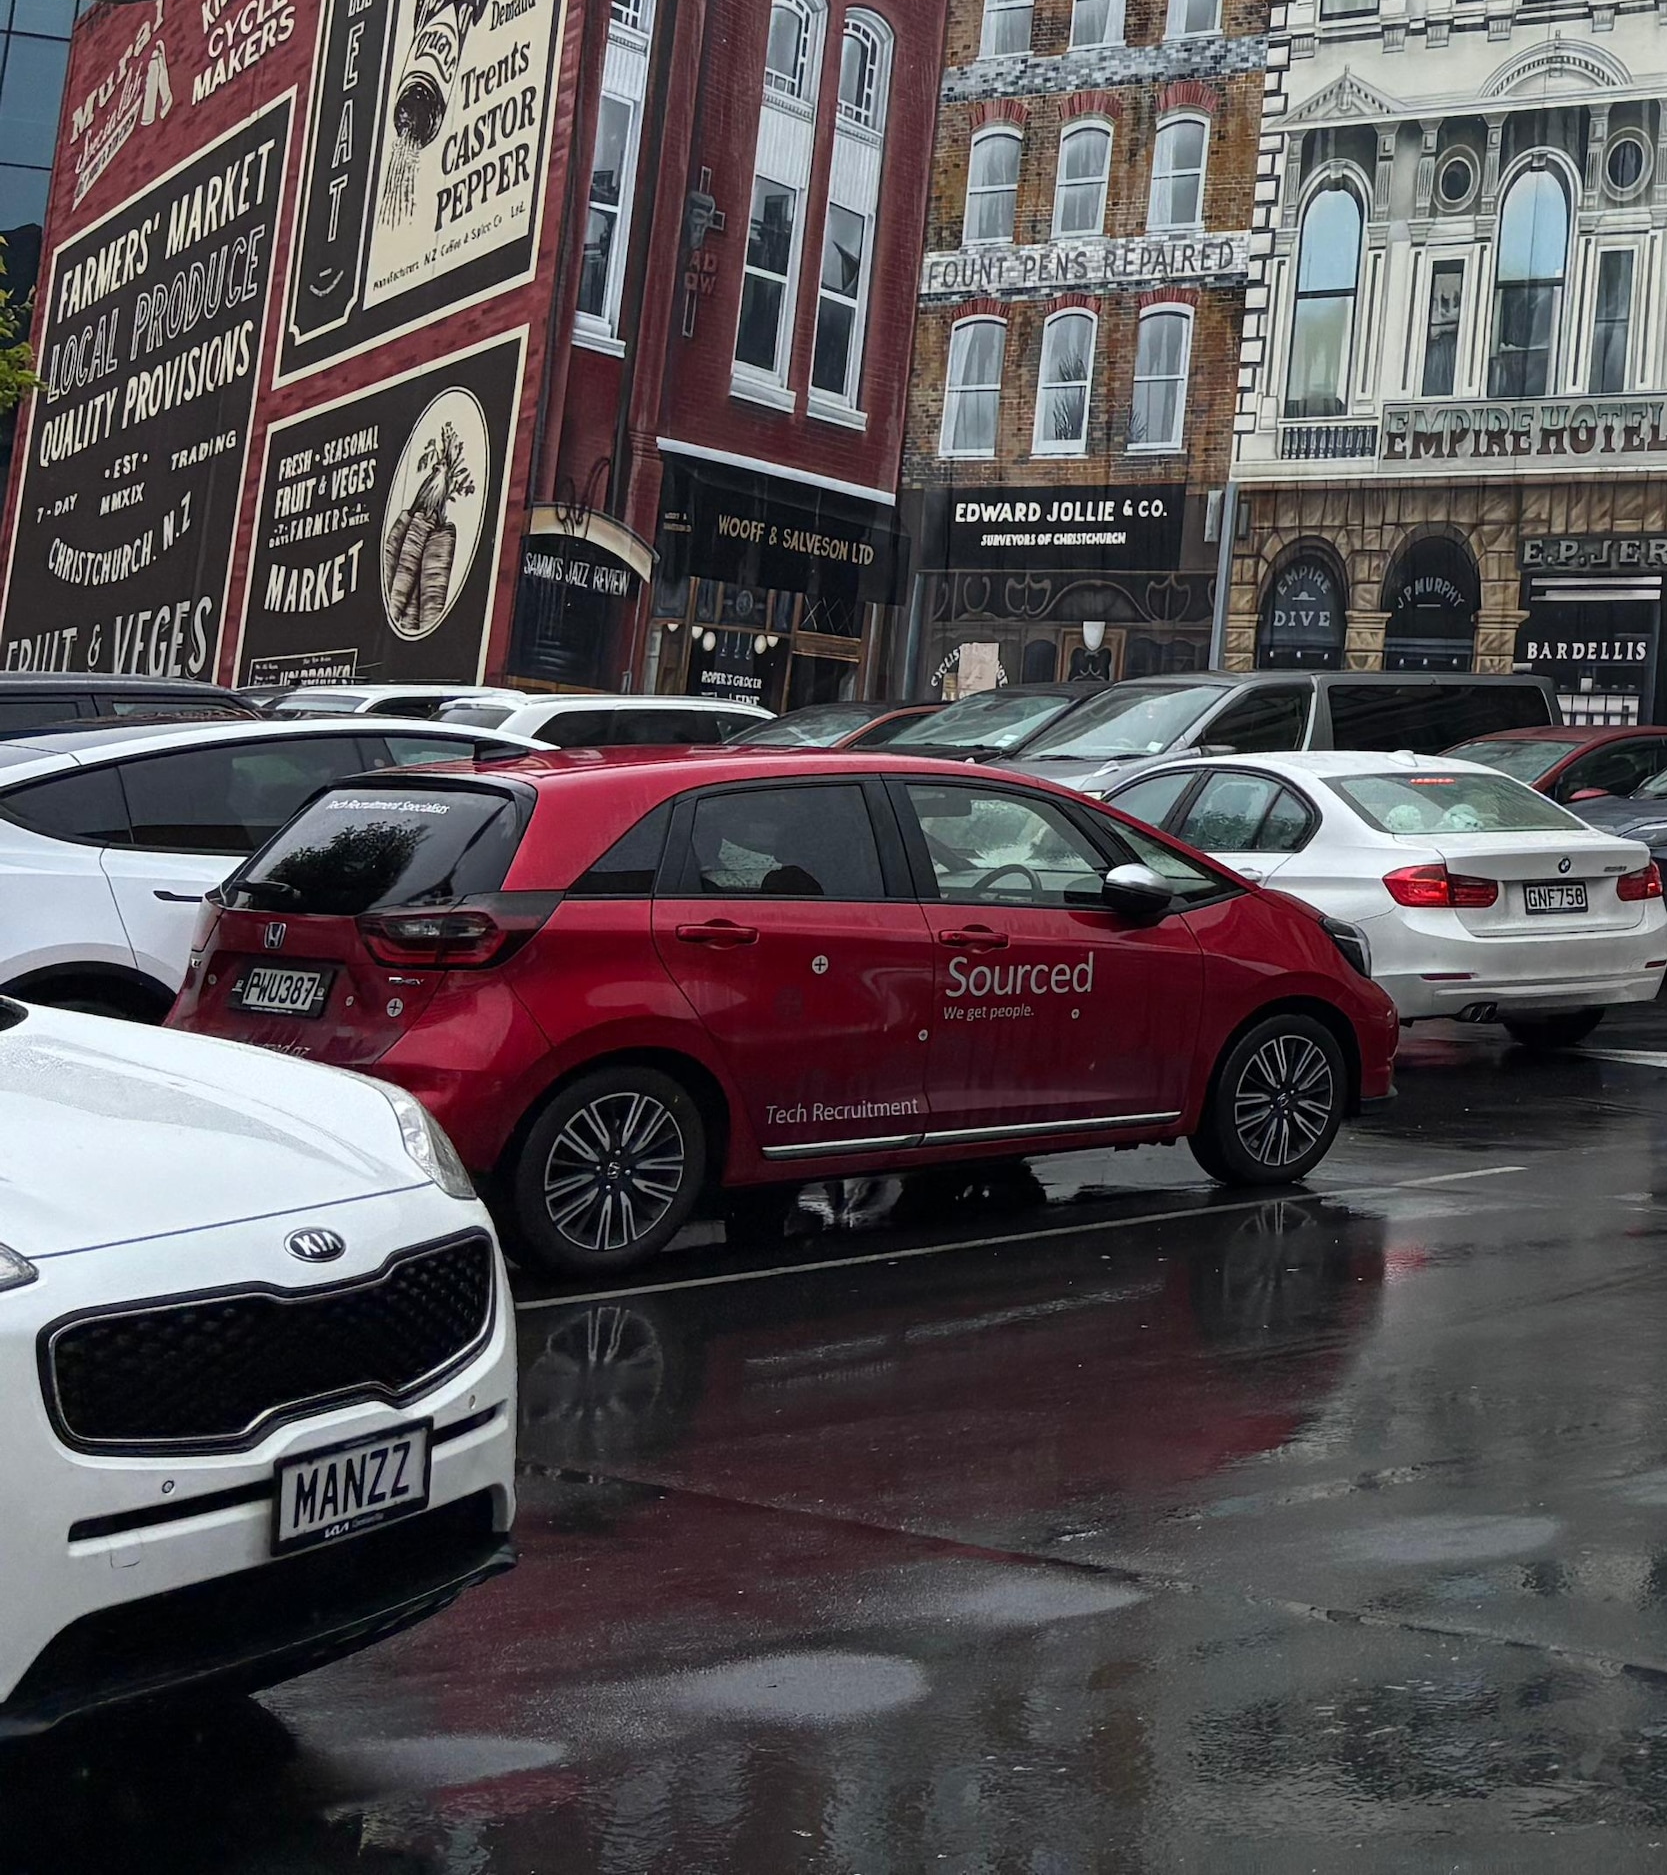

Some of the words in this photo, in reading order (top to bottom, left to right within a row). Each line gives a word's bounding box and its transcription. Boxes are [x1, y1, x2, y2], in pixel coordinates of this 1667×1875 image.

[192, 5, 296, 107] MAKERS
[460, 40, 531, 112] Trents
[441, 85, 538, 176] CASTOR
[165, 139, 275, 259] MARKET
[434, 142, 531, 232] PEPPER
[1021, 243, 1089, 282] PENS
[1103, 238, 1234, 277] REPAIRED
[47, 308, 120, 404] LOCAL
[130, 224, 265, 361] PRODUCE
[40, 387, 118, 468] QUALITY
[122, 320, 254, 430] PROVISIONS
[171, 430, 237, 470] TRADING
[279, 450, 313, 481] FRESH
[322, 425, 379, 466] SEASONAL
[1384, 407, 1533, 460] EMPIRE
[100, 482, 145, 516] MMXIX
[274, 477, 317, 519] FRUIT
[331, 459, 376, 500] VEGES
[955, 502, 1041, 523] EDWARD
[1046, 499, 1115, 522] JOLLIE
[1123, 499, 1133, 517] &
[1137, 498, 1168, 518] CO.
[289, 506, 348, 542] FARMERS
[718, 513, 765, 543] WOOFF
[783, 532, 848, 561] SALVESON
[852, 543, 874, 566] LTD
[981, 532, 1036, 546] SURVEYORS
[1037, 532, 1053, 546] OF
[1053, 531, 1126, 545] CHRISTCHURCH
[264, 540, 363, 612] MARKET
[565, 559, 588, 588] JAZZ
[593, 565, 630, 597] REVIEW
[1277, 566, 1331, 596] EMPIRE
[1415, 577, 1465, 607] MURPHY
[1274, 611, 1331, 627] DIVE
[1526, 640, 1648, 661] BARDELLIS
[945, 951, 1095, 1000] Sourced
[943, 1006, 964, 1020] We
[967, 1009, 987, 1022] get
[765, 1104, 808, 1125] Tech
[812, 1098, 919, 1122] Recruitment
[295, 1230, 341, 1258] KIA
[293, 1441, 411, 1529] MANZZ
